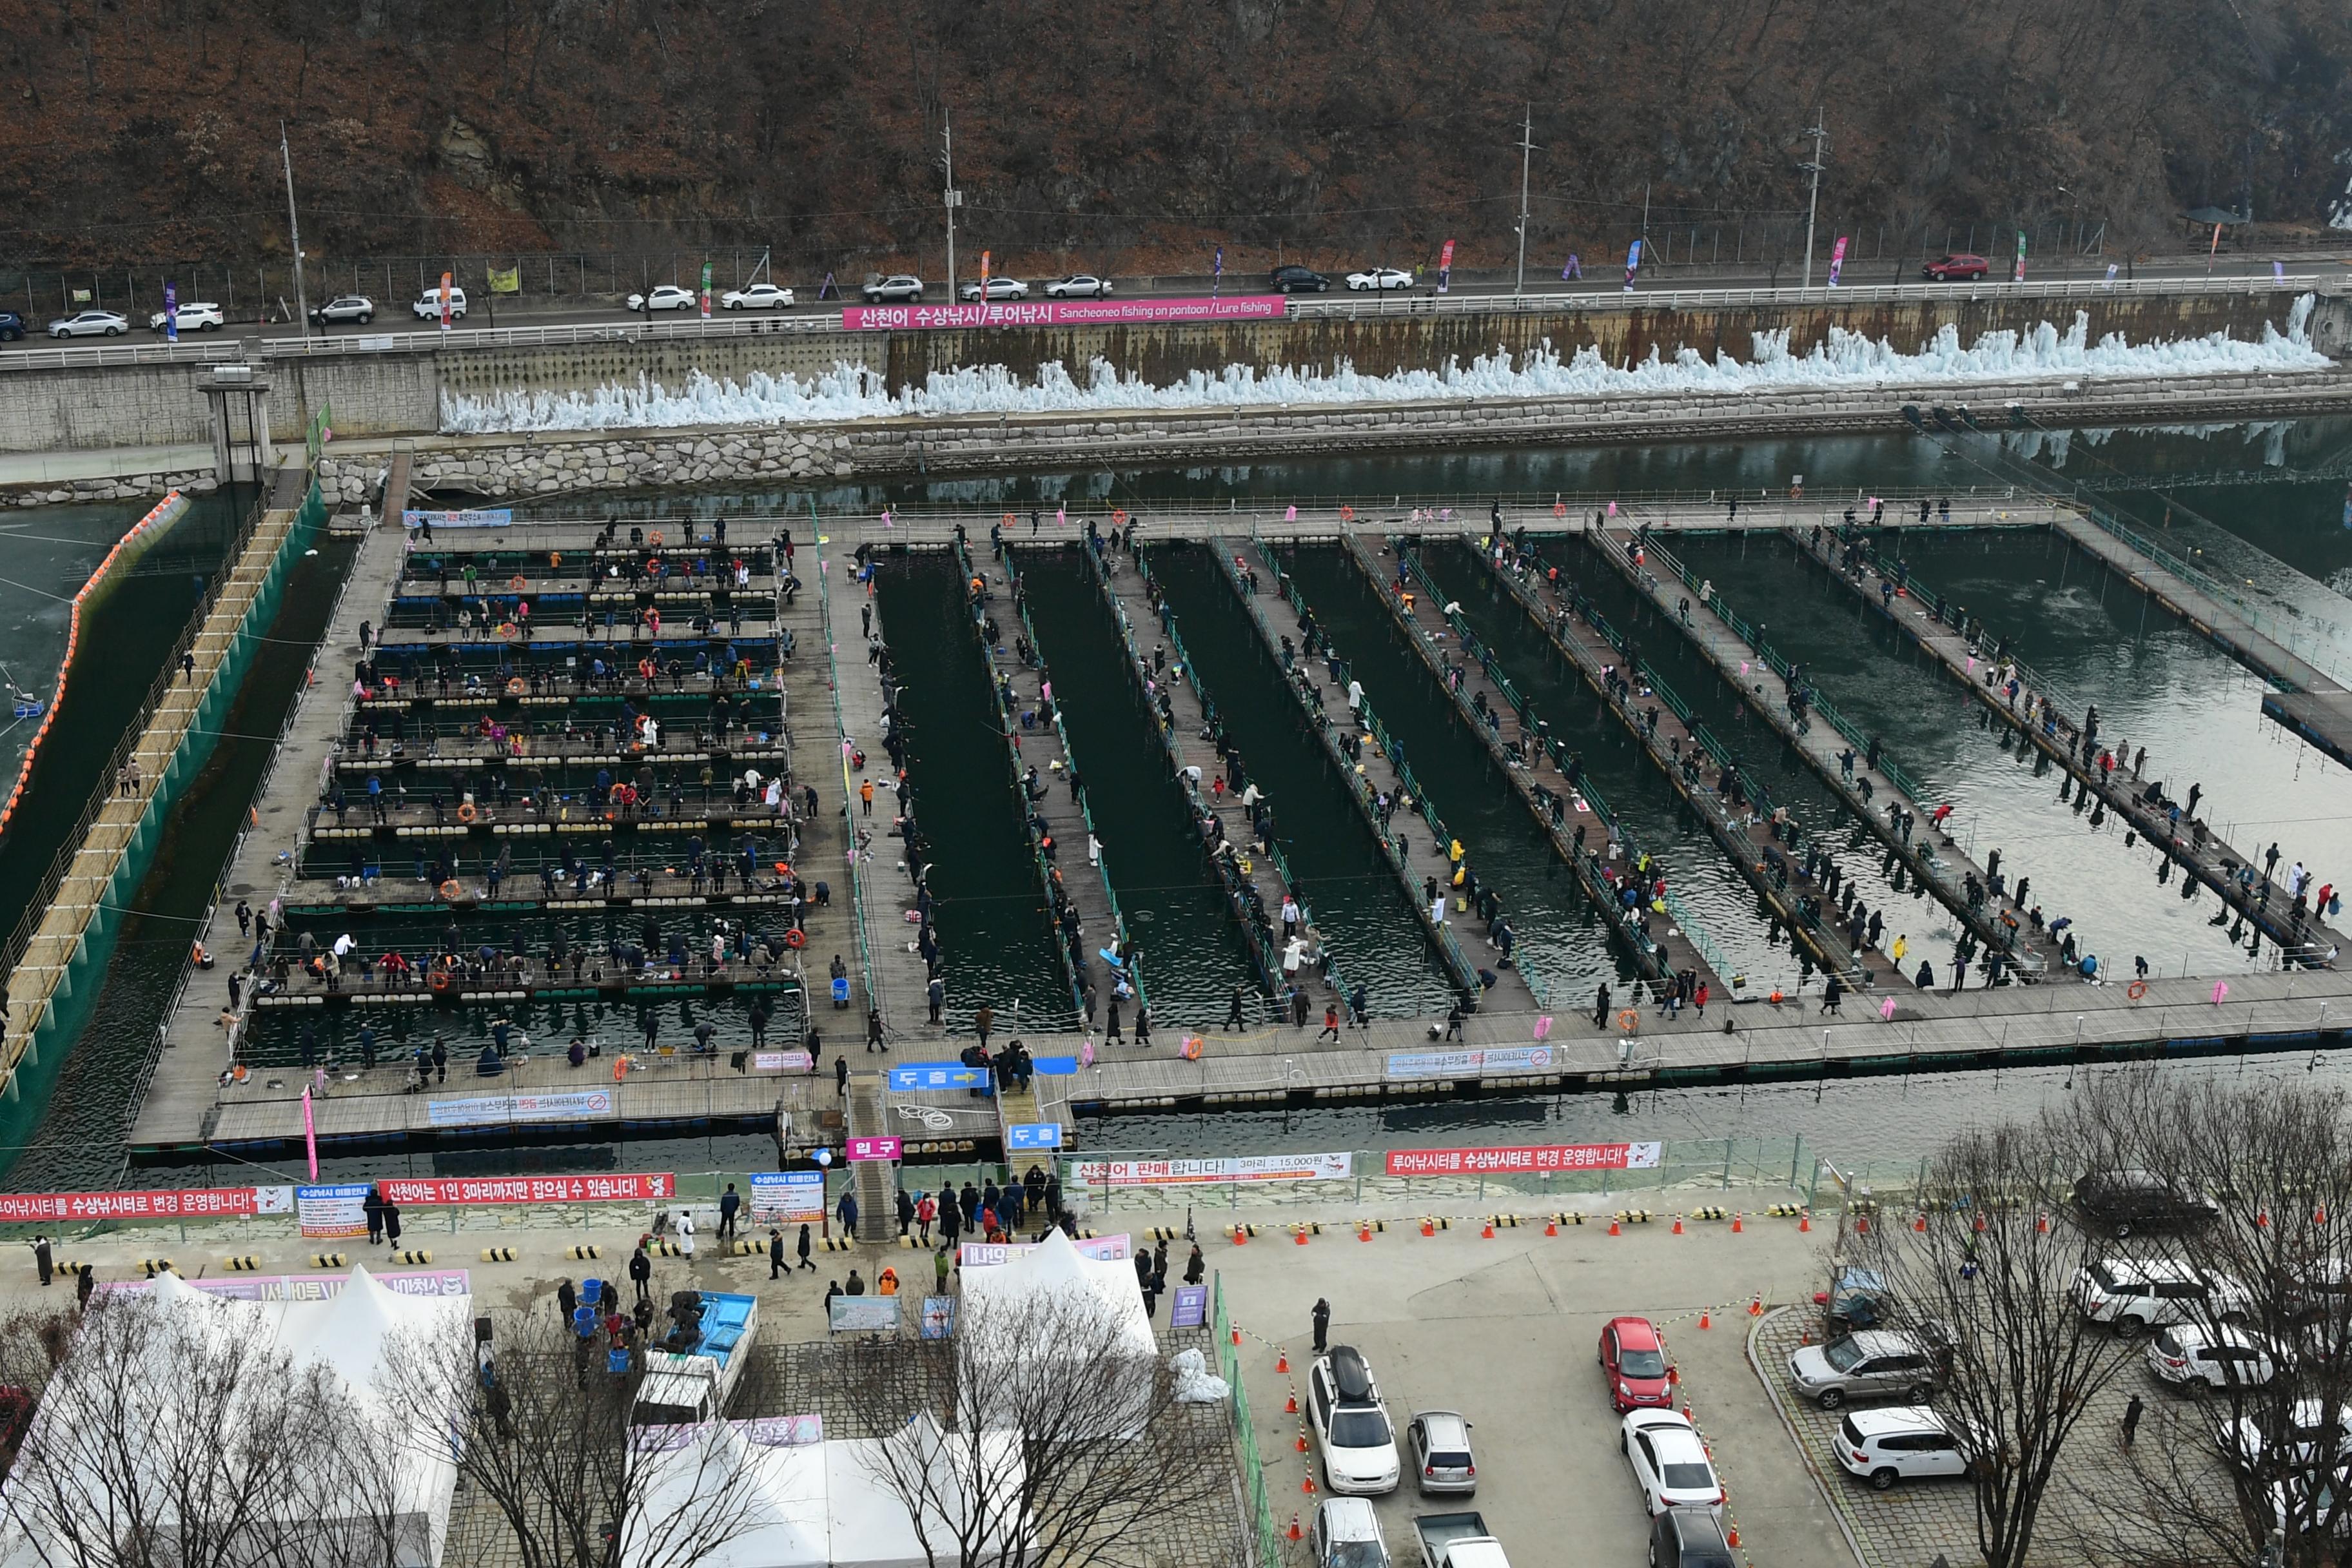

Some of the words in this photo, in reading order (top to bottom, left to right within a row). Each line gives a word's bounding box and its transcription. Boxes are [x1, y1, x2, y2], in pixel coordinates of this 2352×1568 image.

[859, 308, 908, 328] 산천어
[914, 304, 1052, 326] 수상낚시/루어낚시
[1059, 306, 1120, 318] Sancheoneo
[1122, 304, 1153, 319] fishing
[1155, 306, 1168, 315] on
[1169, 304, 1209, 317] pontoon
[1240, 301, 1273, 315] fishing
[1240, 1159, 1266, 1168] 3마리
[1280, 1156, 1322, 1166] 15,000원
[1392, 1152, 1461, 1171] 루어낚시터를
[1464, 1150, 1533, 1169] 수상낚시터로
[1536, 1149, 1560, 1167] 변경
[1562, 1146, 1622, 1166] 운영합니다!
[1079, 1161, 1130, 1178] 산천어
[1137, 1159, 1226, 1176] 판매합니다!
[754, 1175, 786, 1184] 수상낚시
[788, 1174, 820, 1183] 이용안내
[300, 1188, 334, 1197] 수상낚시
[335, 1186, 368, 1197] 이용안내
[388, 1181, 436, 1202] 산천어는
[439, 1181, 460, 1201] 1인
[462, 1179, 529, 1201] 3마리까지만
[531, 1179, 568, 1199] 잡으실
[571, 1179, 584, 1196] 수
[587, 1176, 638, 1197] 있습니다!
[72, 1195, 150, 1215] 수상낚시터로
[153, 1194, 179, 1213] 변경
[182, 1191, 250, 1212] 운영합니다!
